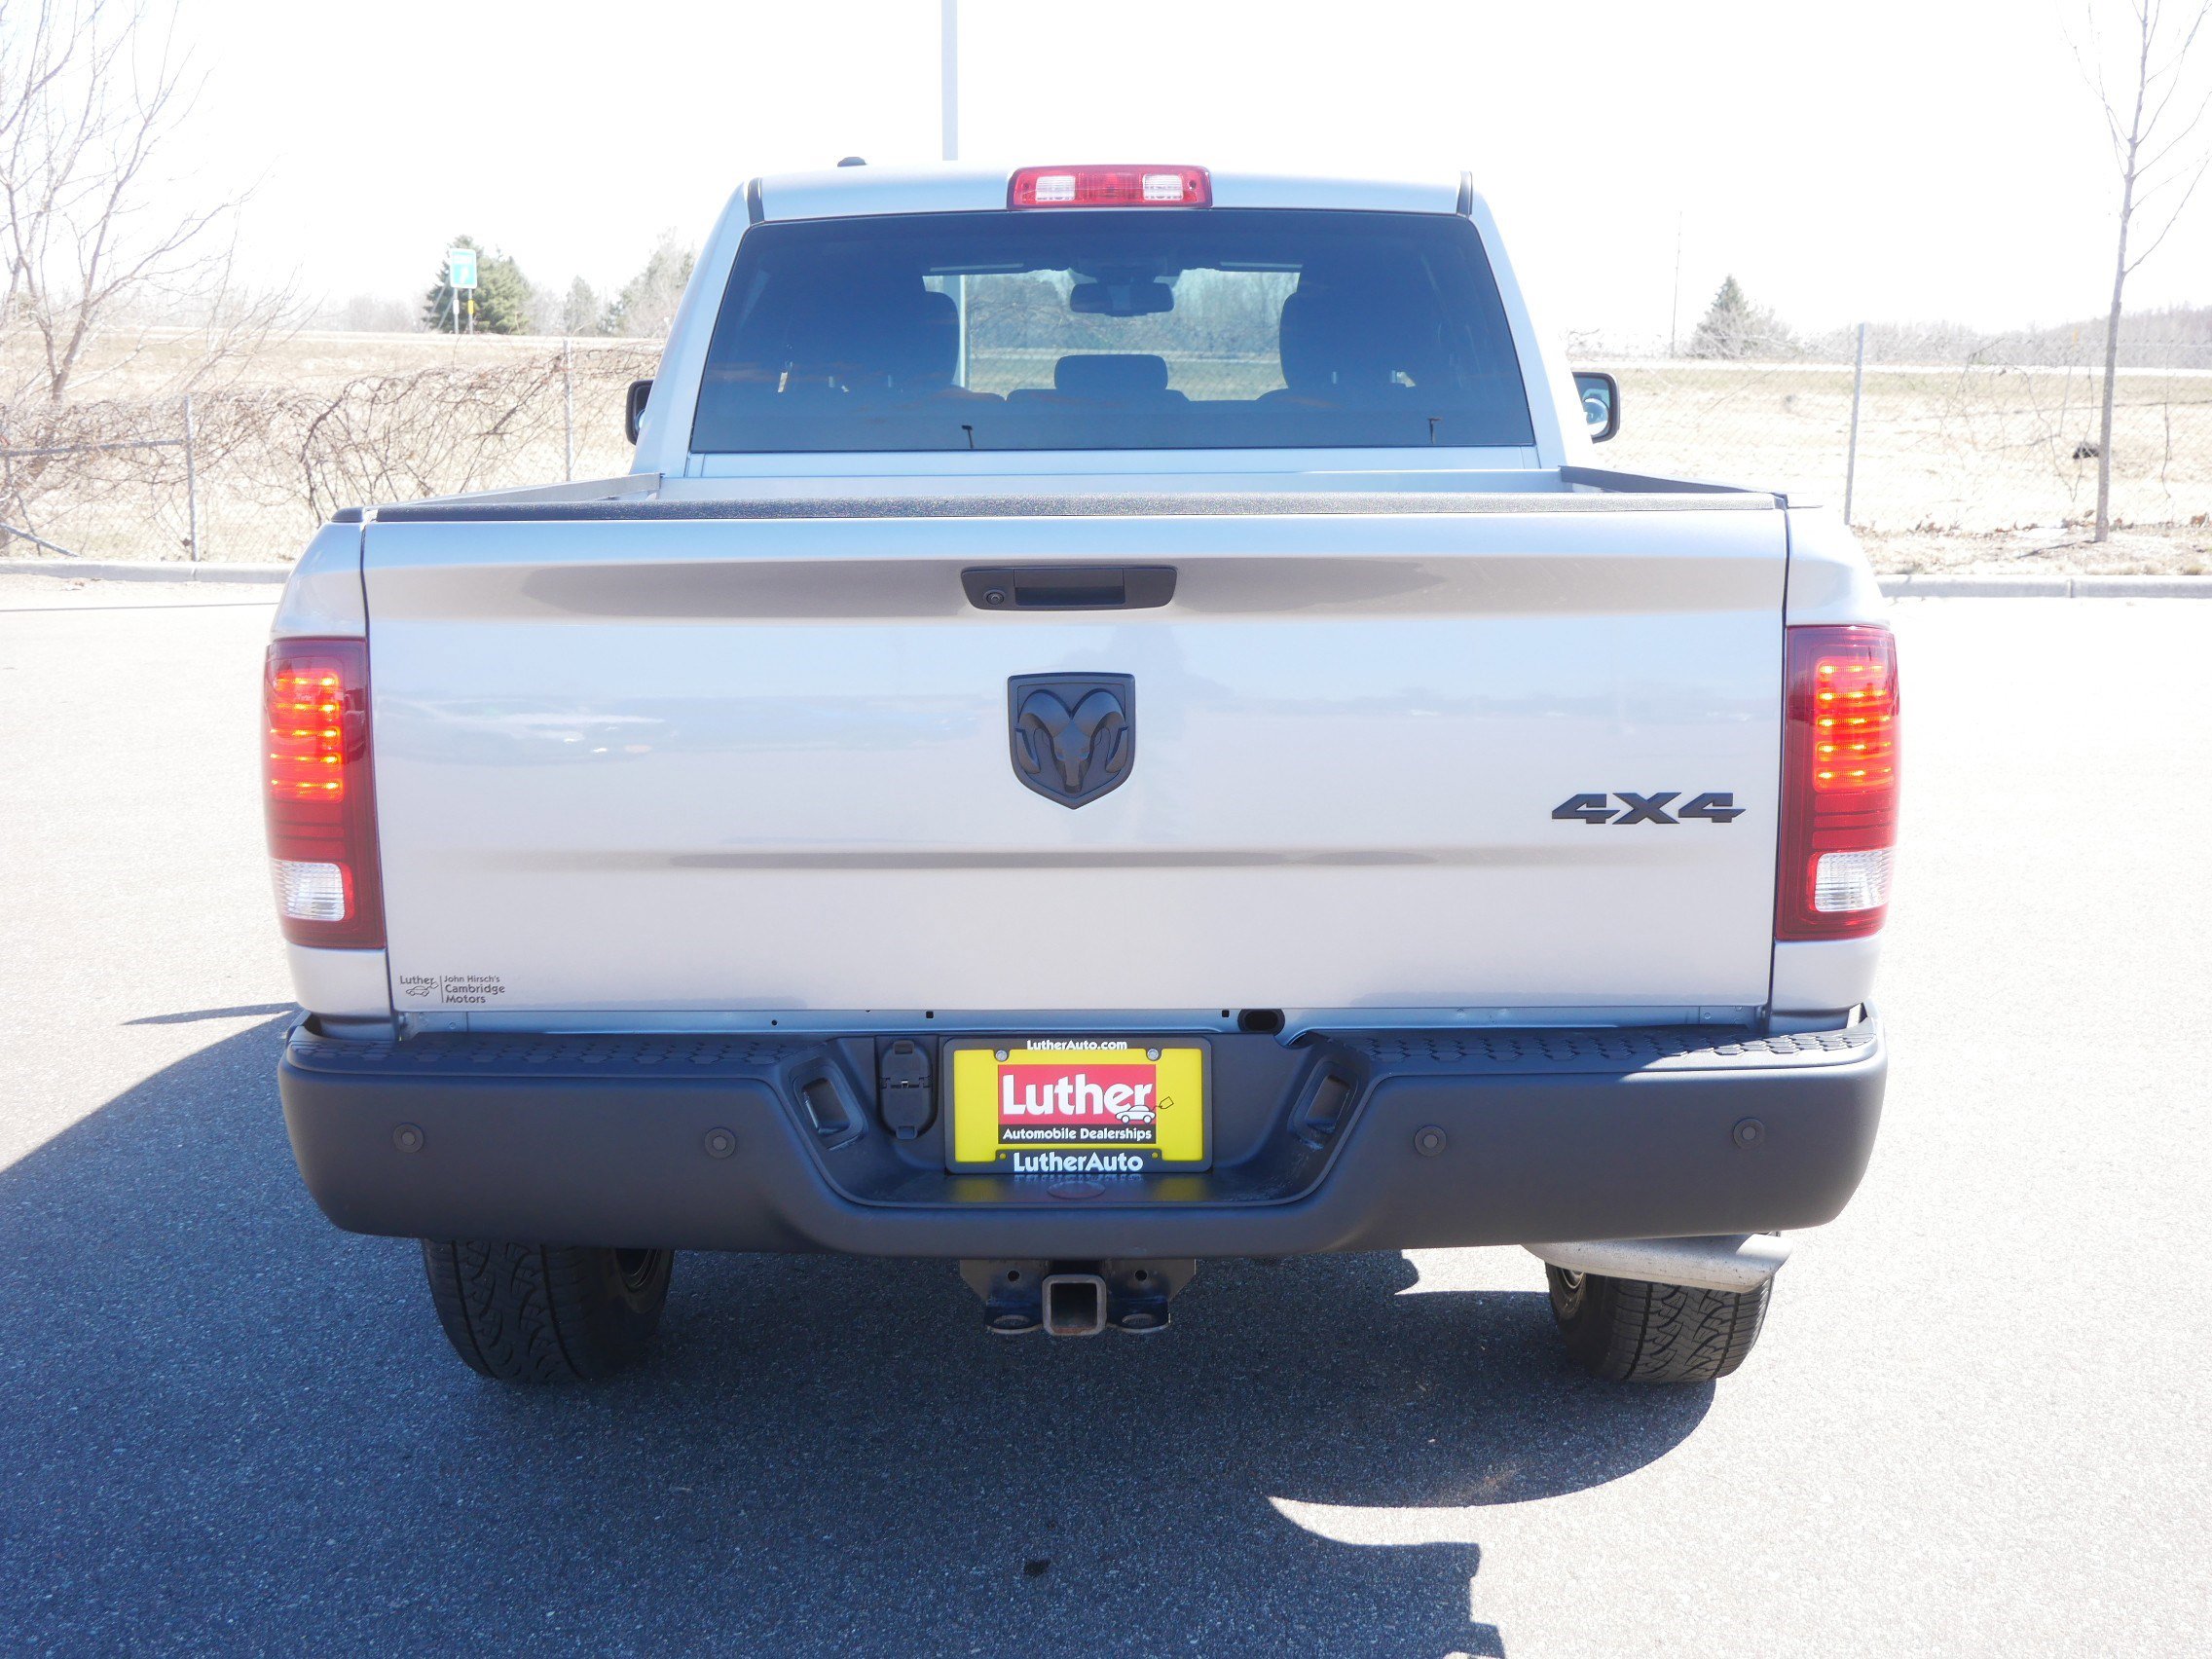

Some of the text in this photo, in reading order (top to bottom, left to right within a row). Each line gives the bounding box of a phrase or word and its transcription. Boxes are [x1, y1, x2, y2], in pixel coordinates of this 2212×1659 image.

[1551, 792, 1747, 826] 4X4
[399, 975, 435, 985] Luther
[444, 975, 500, 983] John Hirsch's
[444, 983, 506, 996] Cambridge
[445, 994, 487, 1004] Motors
[1026, 1039, 1128, 1051] LutherAuto.com
[1002, 1073, 1154, 1116] Luther
[1002, 1126, 1153, 1143] Automobile Dealerships
[1013, 1150, 1144, 1173] LutherAuto
